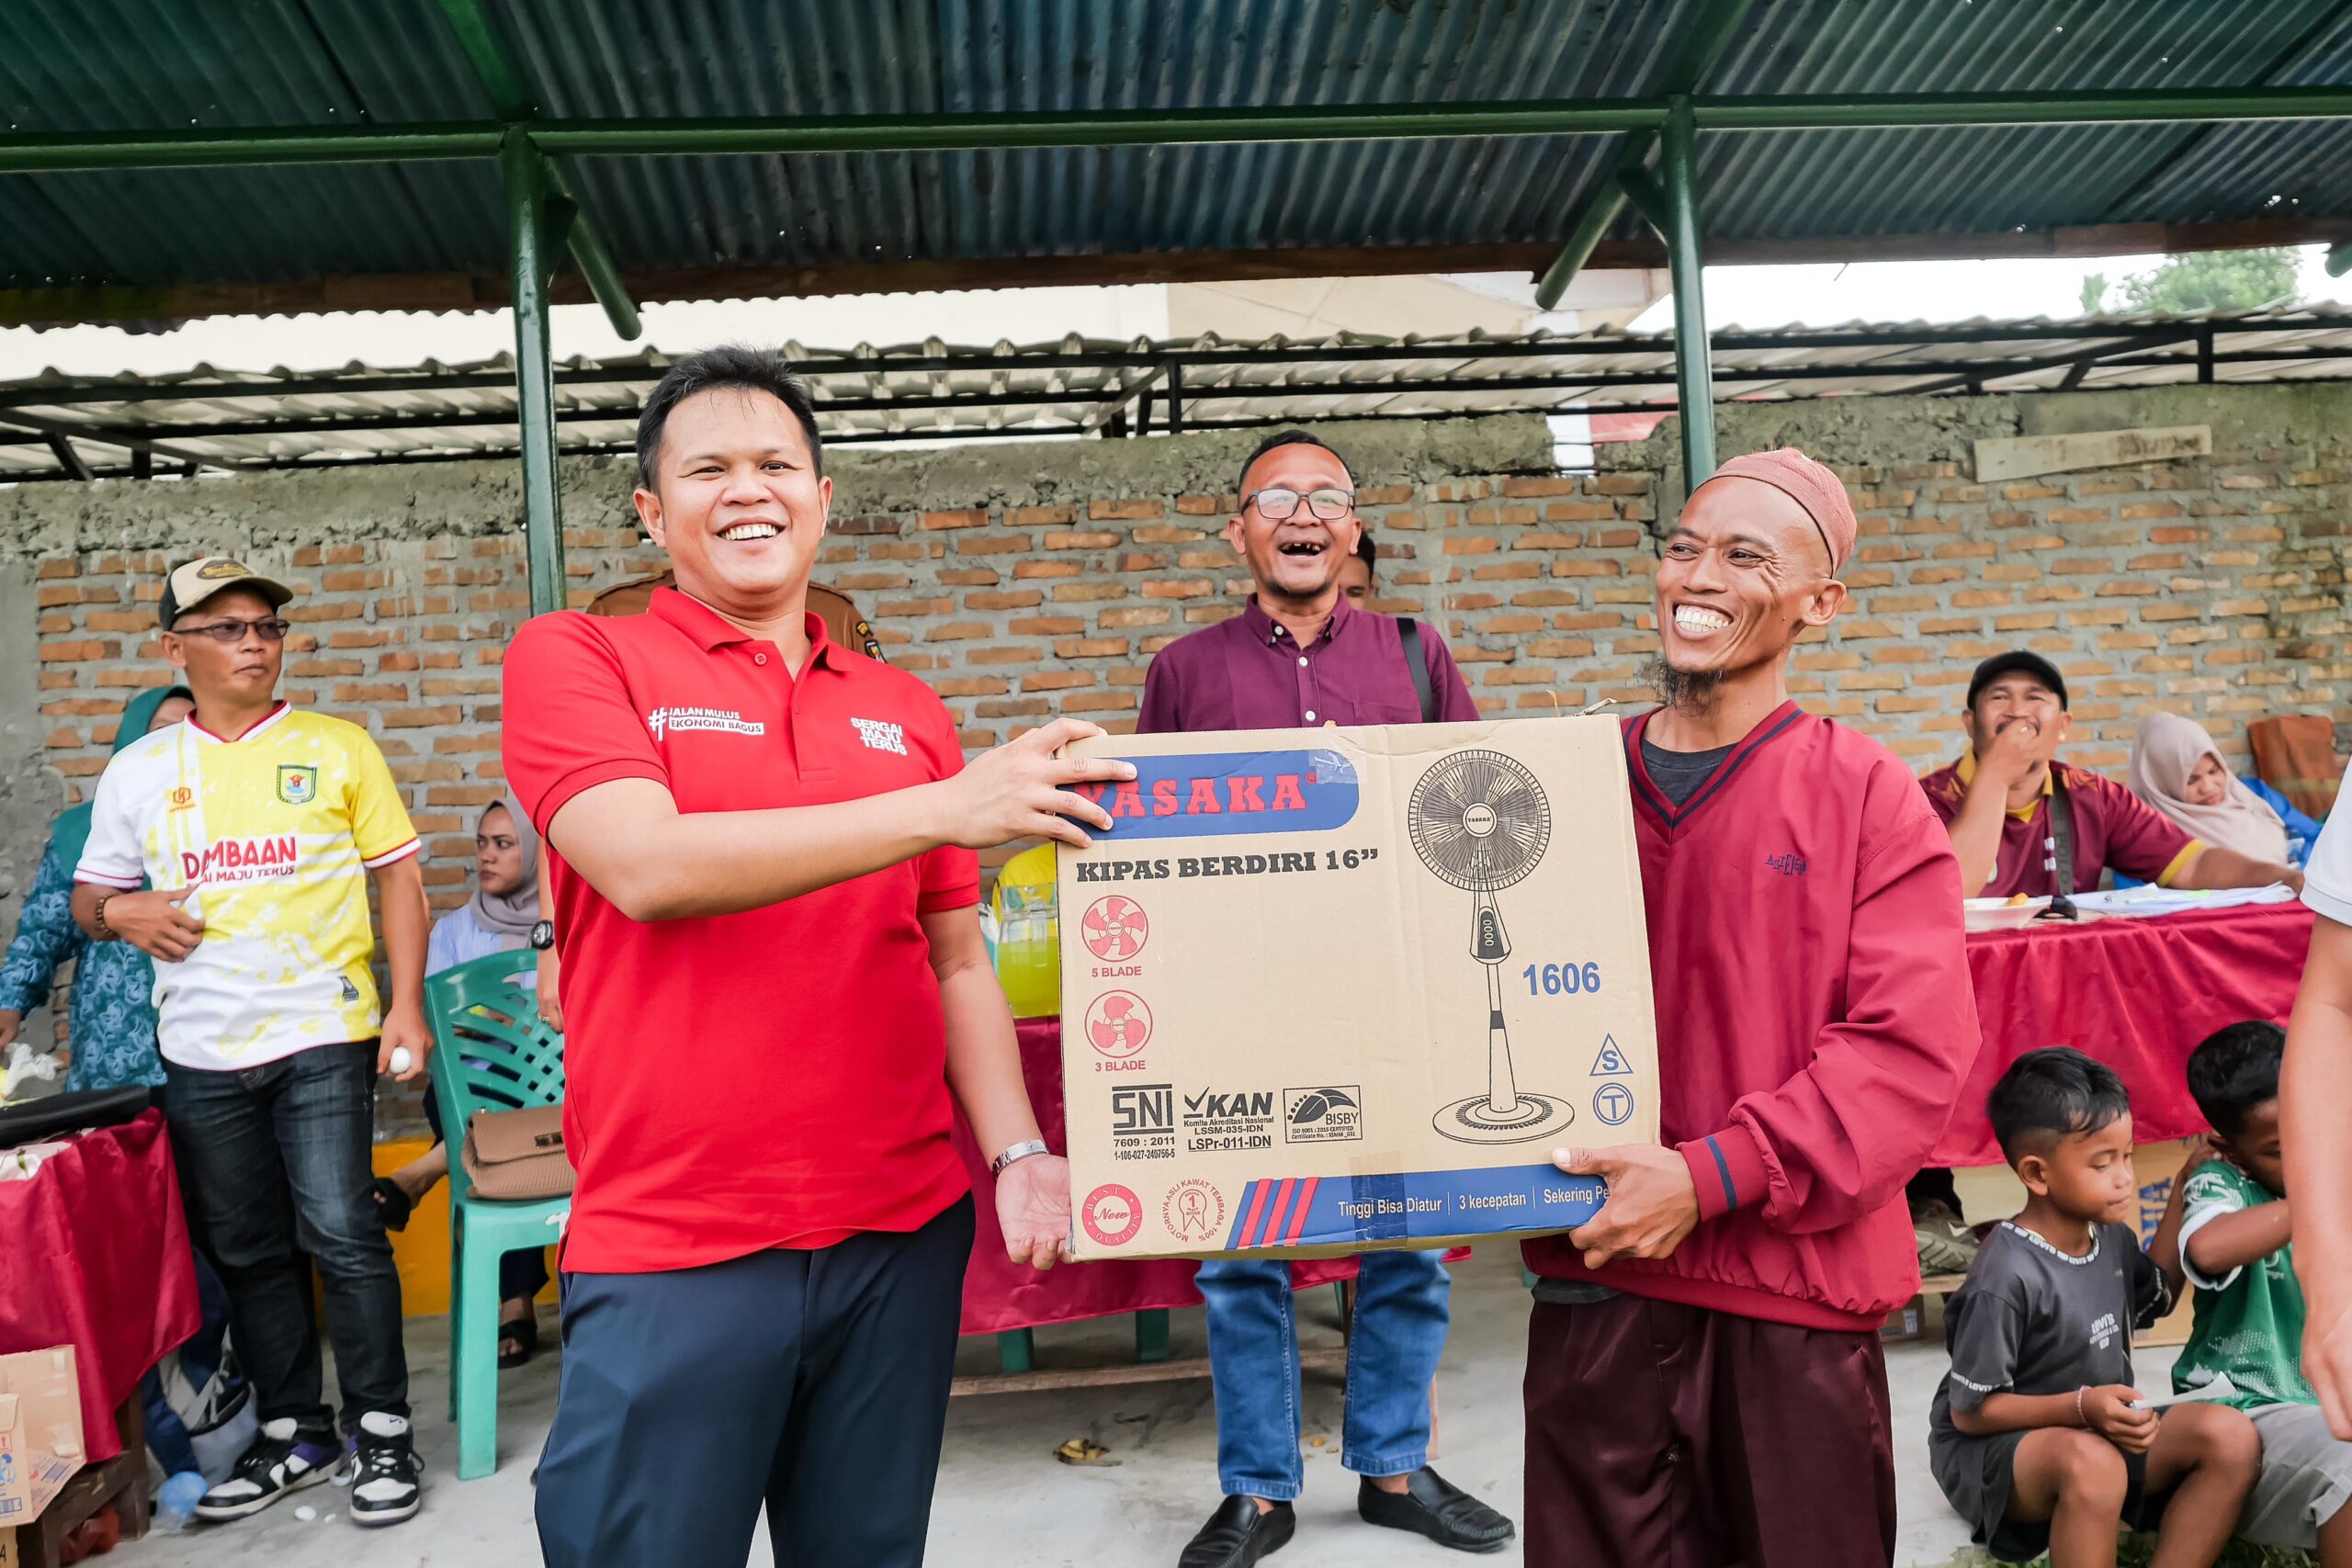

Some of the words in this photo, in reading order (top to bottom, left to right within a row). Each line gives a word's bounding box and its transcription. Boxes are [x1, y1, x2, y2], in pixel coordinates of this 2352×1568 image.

[668, 706, 704, 716] JALAN
[704, 709, 741, 719] MULUS
[671, 718, 725, 728] EKONOMI
[729, 721, 762, 733] BAGUS
[850, 717, 903, 737] SERGAI
[860, 728, 902, 744] MAJU
[859, 736, 908, 756] TERUS
[216, 869, 253, 882] MAJU
[256, 864, 295, 878] TERUS
[1076, 859, 1170, 882] KIPAS
[1177, 852, 1317, 878] BERDIRI
[1091, 967, 1098, 977] 5
[1102, 966, 1142, 977] BLADE
[1522, 962, 1601, 996] 1606
[1094, 1062, 1102, 1072] 3
[1105, 1060, 1147, 1072] BLADE
[1601, 1050, 1620, 1071] S
[1112, 1089, 1174, 1130] SNI
[1205, 1092, 1273, 1118] KAN
[1601, 1094, 1624, 1120] T
[1325, 1111, 1359, 1125] BISBY
[1194, 1124, 1264, 1135] LSSM-035-IDN
[1114, 1138, 1140, 1147] 7609
[1150, 1136, 1175, 1146] 2011
[1188, 1135, 1272, 1150] LSPr-011-IDN
[1181, 1179, 1211, 1189] KAWAT
[1338, 1200, 1374, 1219] Tinggi
[1378, 1199, 1404, 1215] Bisa
[1407, 1197, 1442, 1213] Diatur
[1459, 1194, 1466, 1210] 3
[1469, 1191, 1527, 1212] kecepatan
[1544, 1187, 1593, 1205] Sekering
[1595, 1185, 1611, 1201] Pe
